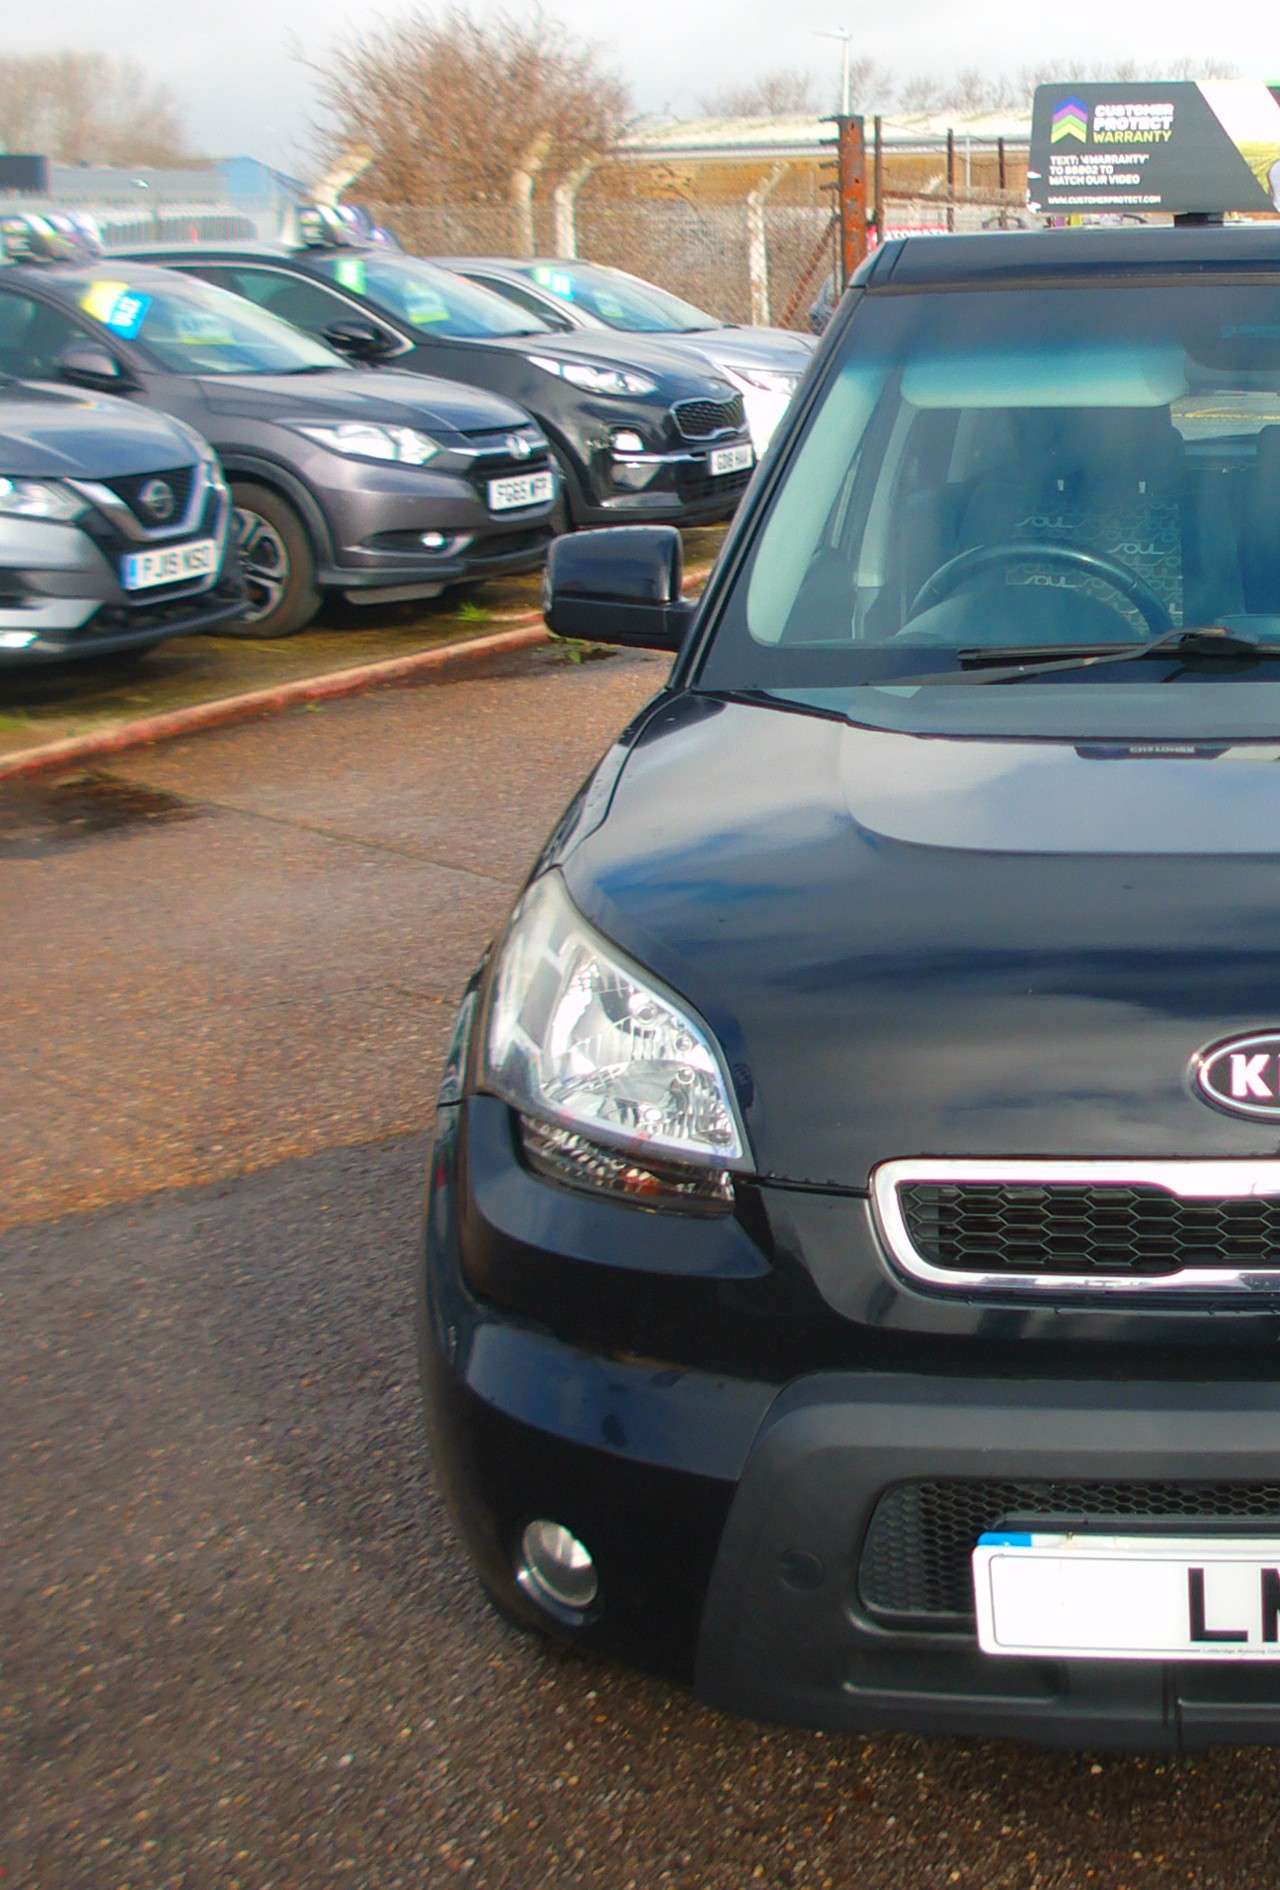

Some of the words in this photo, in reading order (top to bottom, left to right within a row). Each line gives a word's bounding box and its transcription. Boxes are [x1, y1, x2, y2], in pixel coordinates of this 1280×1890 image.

[1095, 103, 1174, 117] CUSTOMER
[1094, 116, 1173, 130] PROTECT
[1093, 130, 1172, 143] WARRANTY
[1049, 165, 1063, 175] TO
[1100, 164, 1114, 174] TO
[1086, 174, 1108, 185] OUR
[1109, 173, 1140, 184] VIDEO
